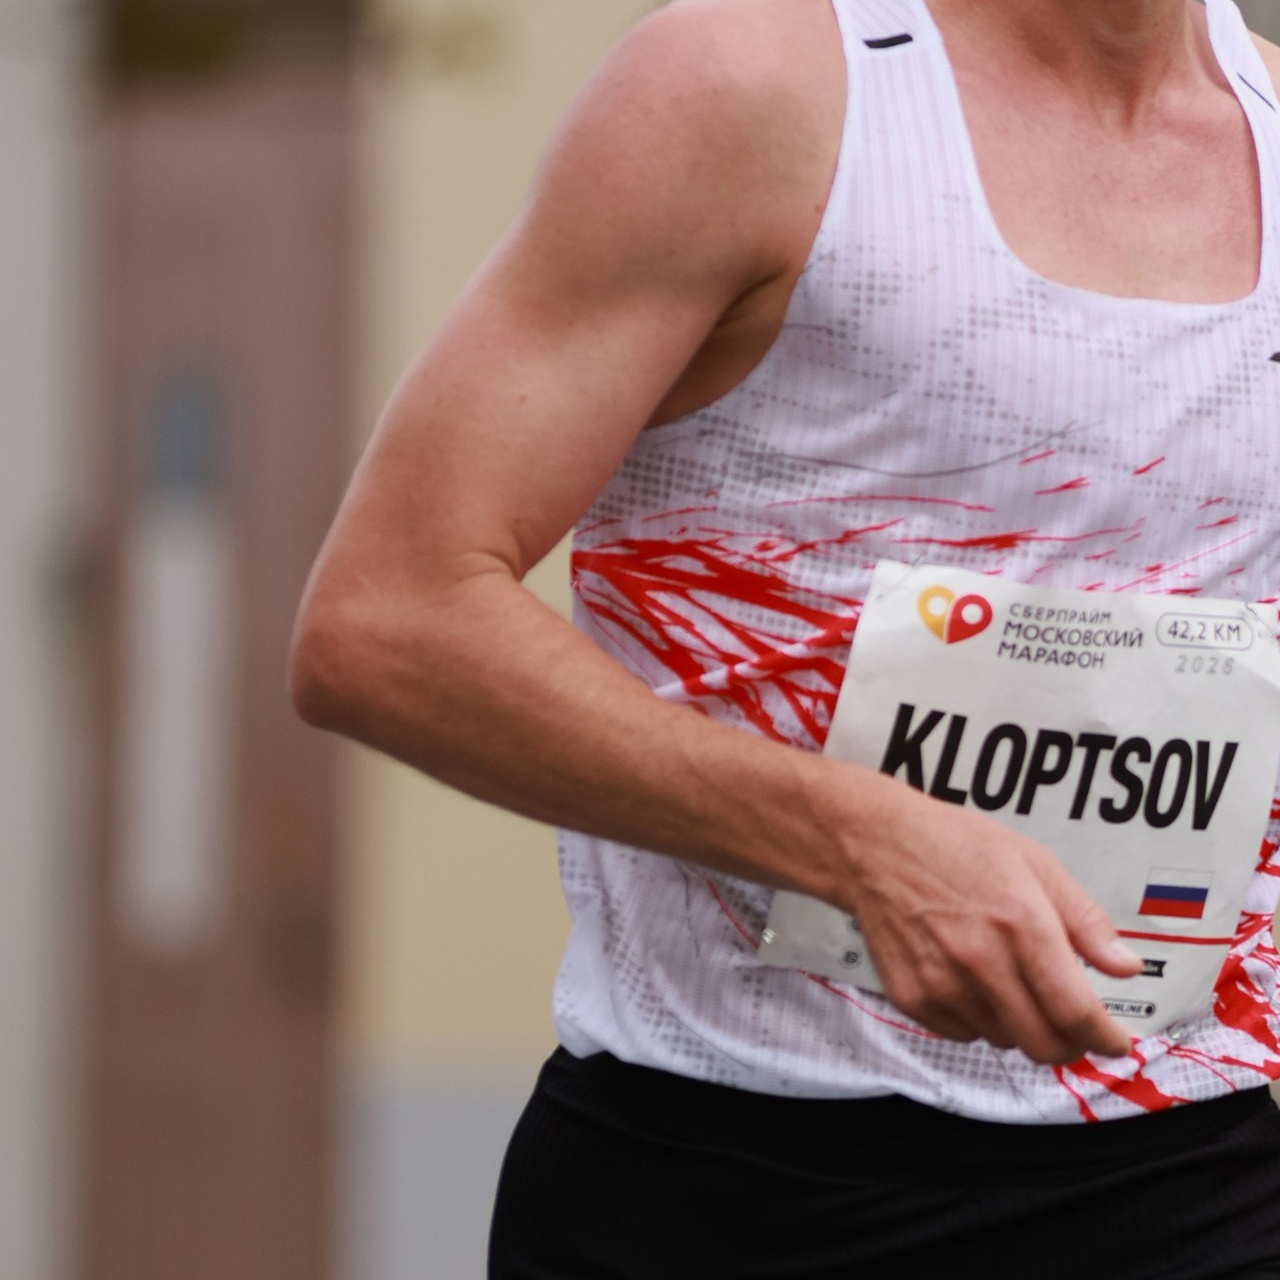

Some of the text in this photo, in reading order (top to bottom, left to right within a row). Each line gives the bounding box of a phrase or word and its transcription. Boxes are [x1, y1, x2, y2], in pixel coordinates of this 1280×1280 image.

[1009, 602, 1112, 624] СБЕРПРАЙМ
[1002, 620, 1143, 649] МОСКОВСКИЙ
[1167, 619, 1207, 641] 42,2
[997, 640, 1106, 669] МАРАФОН
[879, 703, 1239, 831] KLOPTSOV
